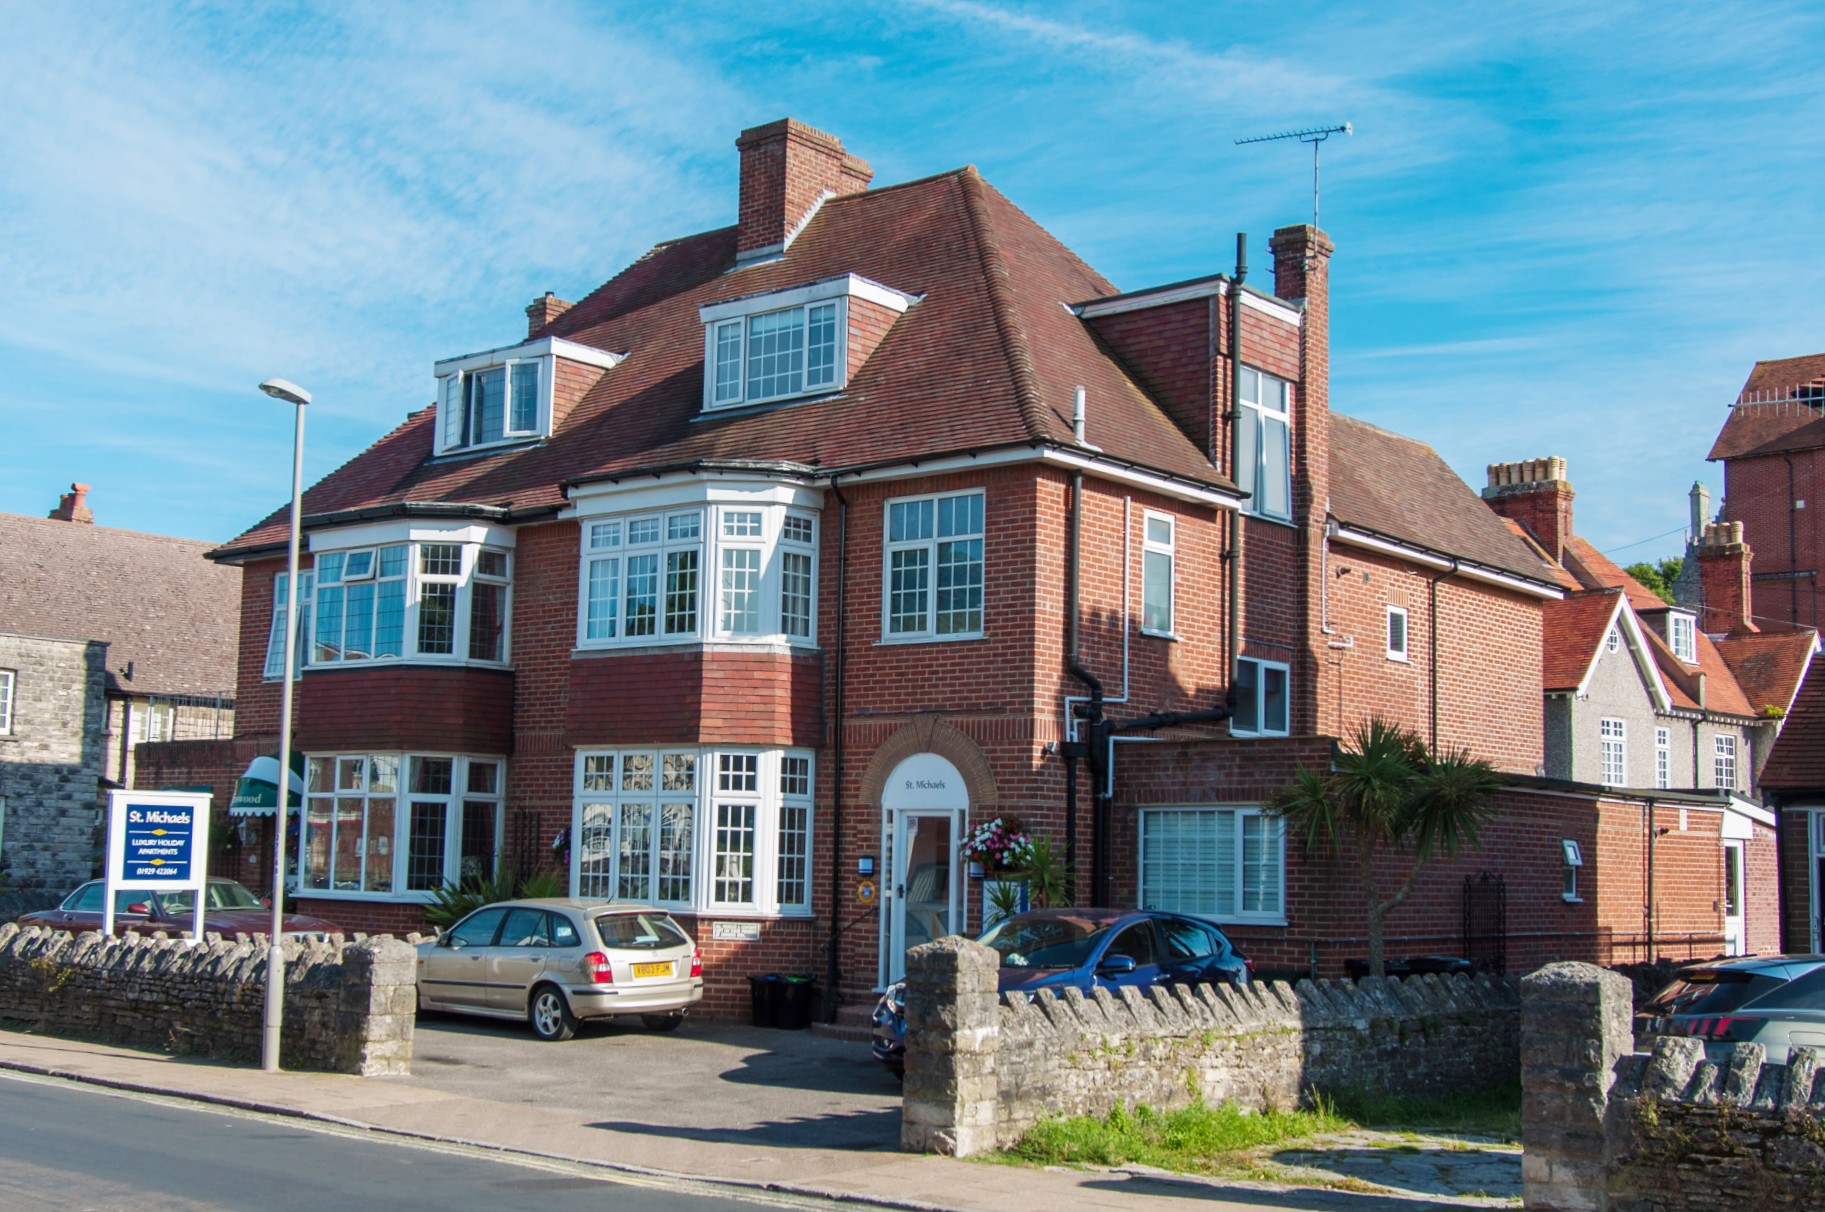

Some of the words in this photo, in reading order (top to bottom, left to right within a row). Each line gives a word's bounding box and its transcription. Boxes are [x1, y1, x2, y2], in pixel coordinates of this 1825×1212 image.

[916, 780, 946, 789] Michaels
[129, 810, 144, 823] St.
[145, 810, 190, 824] Michaels
[132, 838, 157, 846] LUXURY
[157, 839, 186, 847] HOLIDAY
[136, 867, 156, 875] 01929
